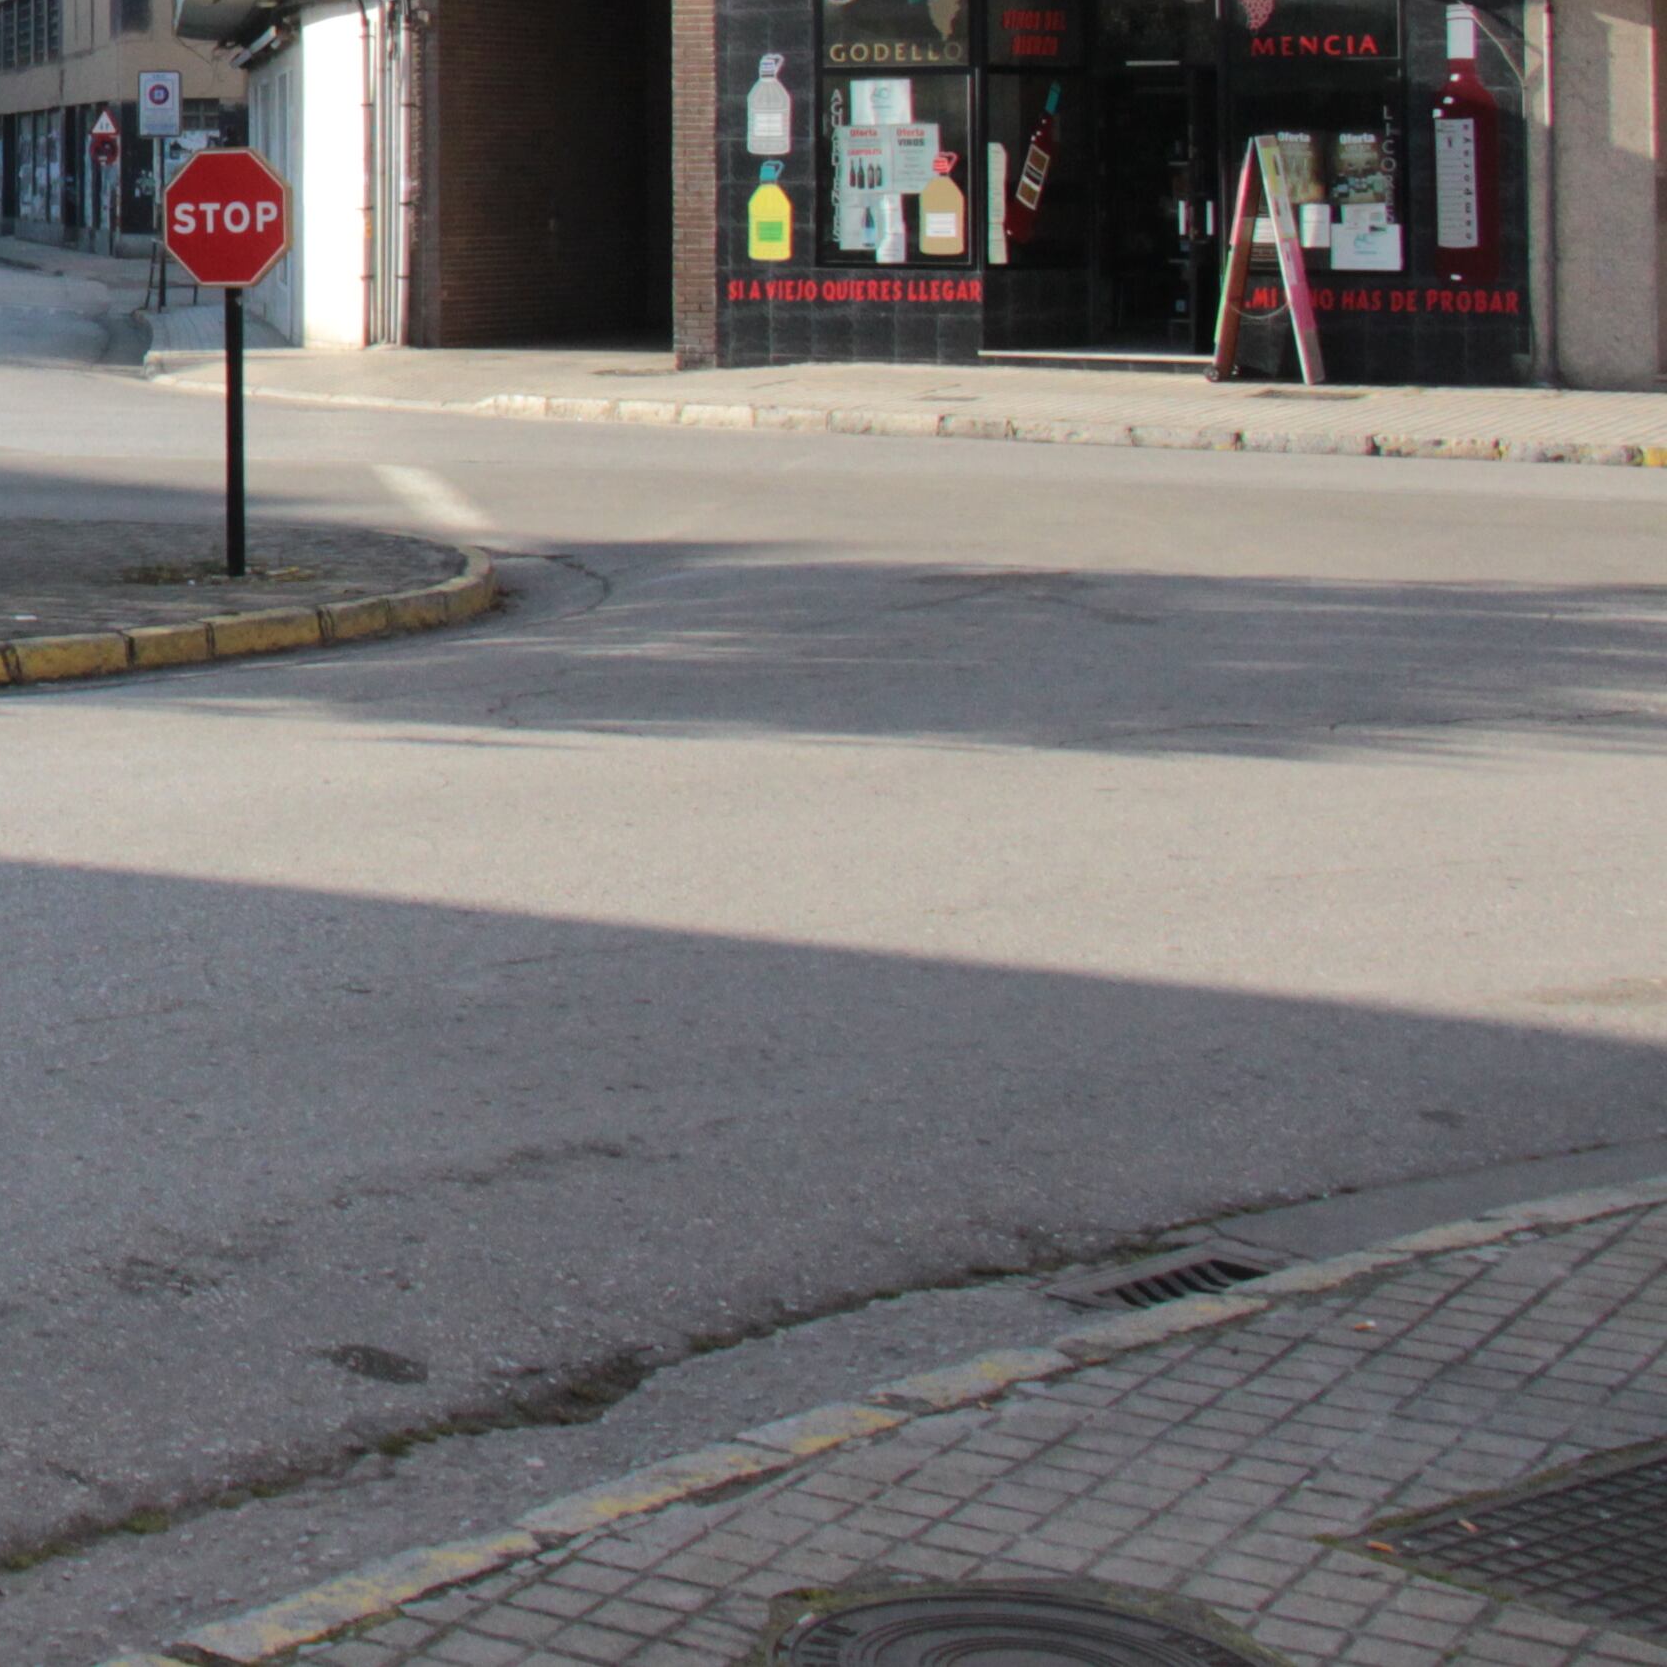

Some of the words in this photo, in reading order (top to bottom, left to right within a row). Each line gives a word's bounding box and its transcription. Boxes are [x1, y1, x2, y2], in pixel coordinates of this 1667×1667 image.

[829, 42, 963, 63] GODELLO
[1250, 35, 1380, 56] MENCIA
[1277, 131, 1310, 143] Oferta
[1339, 133, 1376, 145] Oferta
[173, 201, 279, 234] STOP
[727, 280, 744, 301] SI
[748, 280, 762, 301] A
[765, 280, 817, 302] VIEJO
[822, 280, 903, 302] QUIERES
[907, 280, 983, 302] LLEGAR
[1341, 288, 1382, 312] HAS
[1389, 290, 1418, 312] DE
[1426, 289, 1519, 314] PROBAR
